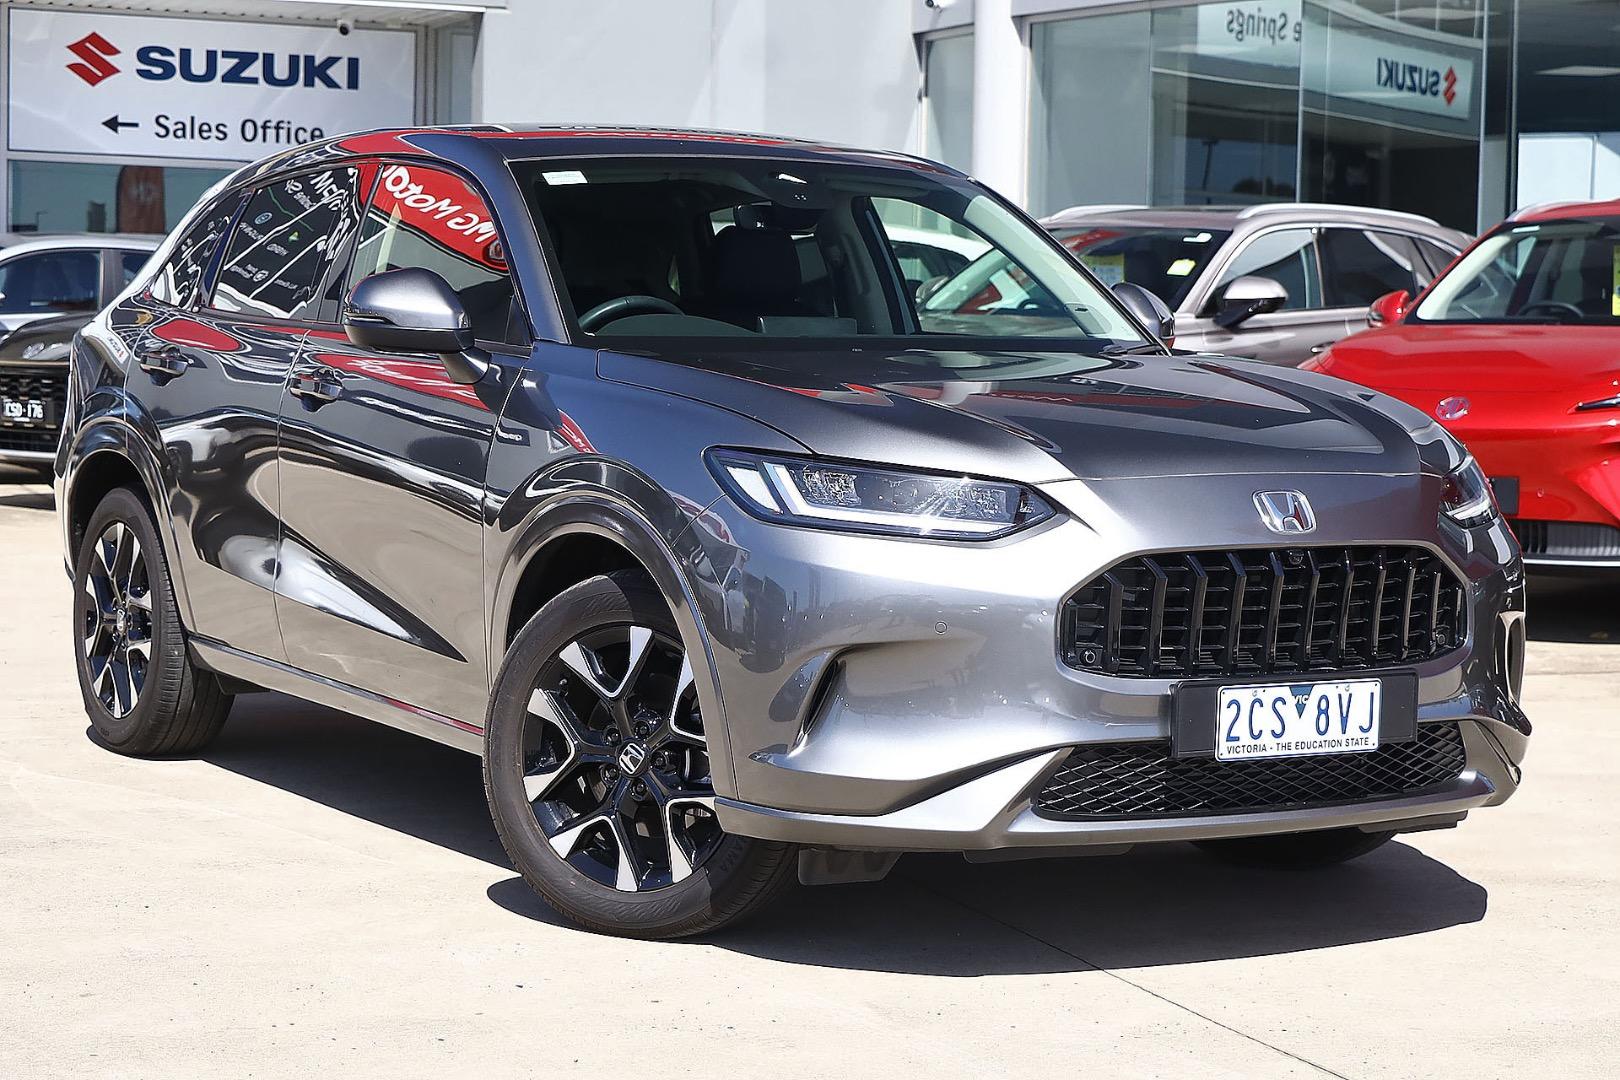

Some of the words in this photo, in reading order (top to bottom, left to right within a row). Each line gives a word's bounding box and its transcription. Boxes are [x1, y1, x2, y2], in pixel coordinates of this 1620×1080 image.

[136, 45, 360, 90] SUZUKI
[154, 114, 228, 141] Sales
[240, 119, 325, 146] Office
[1226, 697, 1286, 741] 2CS
[1315, 692, 1375, 737] 8VJ
[1227, 743, 1267, 755] VICTORIA
[1276, 742, 1292, 752] THE
[1295, 739, 1342, 750] EDUCATION
[1345, 737, 1370, 748] STATE
